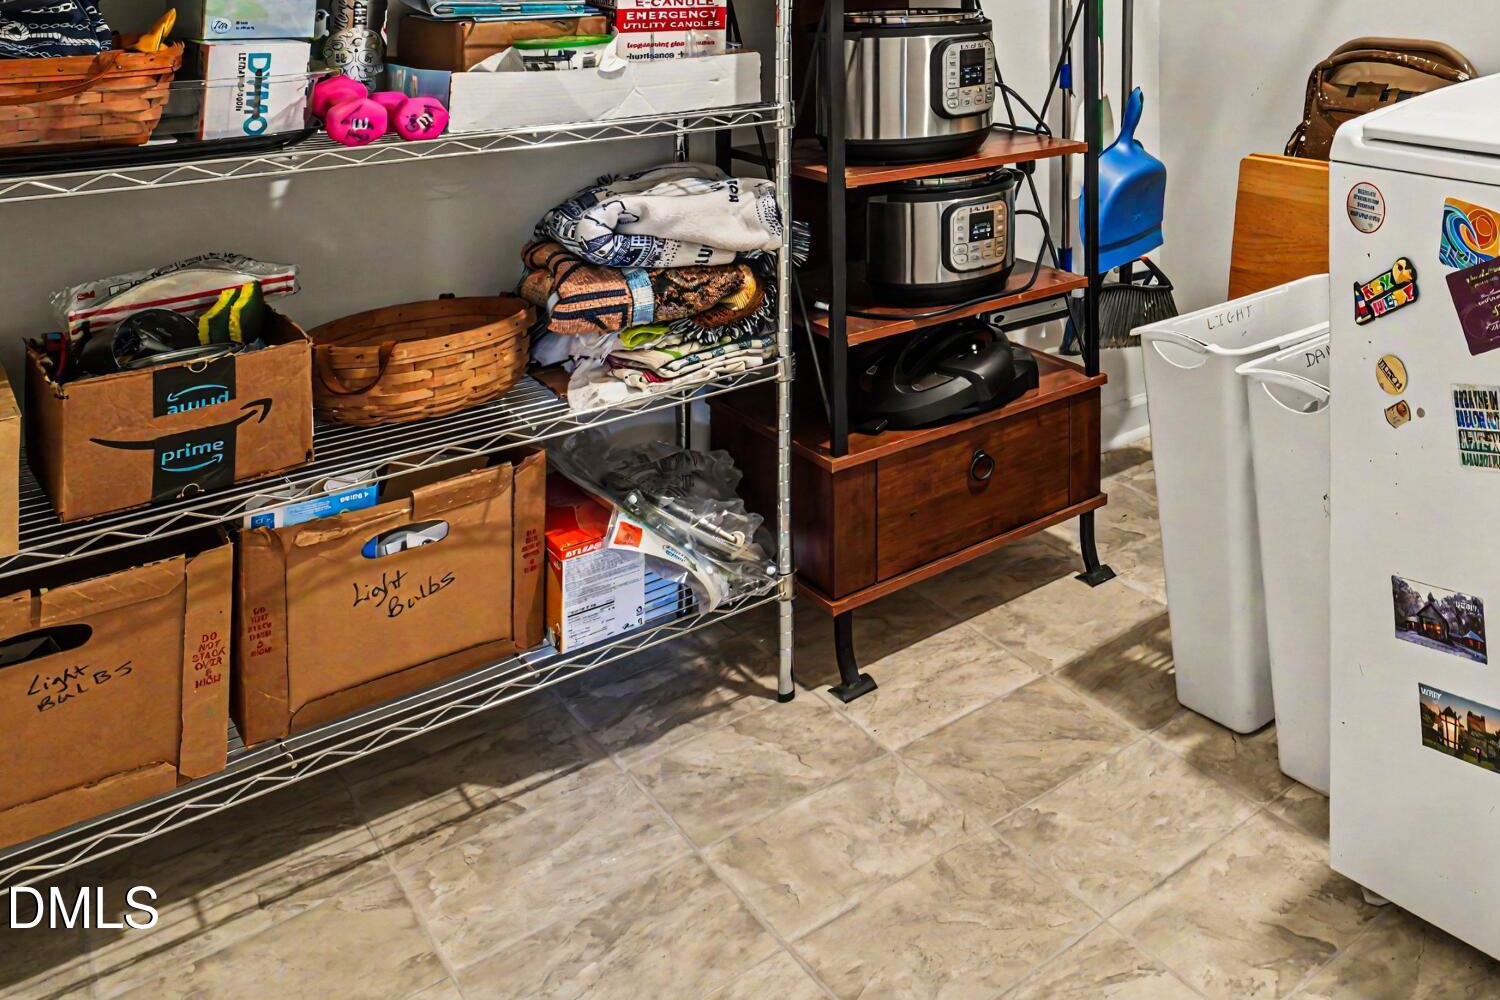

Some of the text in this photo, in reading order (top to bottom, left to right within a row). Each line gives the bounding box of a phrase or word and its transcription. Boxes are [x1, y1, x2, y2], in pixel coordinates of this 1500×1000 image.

[623, 20, 721, 30] UTILITY CANDLES
[626, 10, 717, 21] EMERGENCY
[243, 52, 272, 136] DYMO
[1207, 304, 1253, 330] LIGHT
[161, 439, 224, 466] prime
[353, 570, 408, 607] Light
[198, 640, 221, 652] NOT
[202, 632, 217, 643] DO
[28, 665, 90, 696] Light
